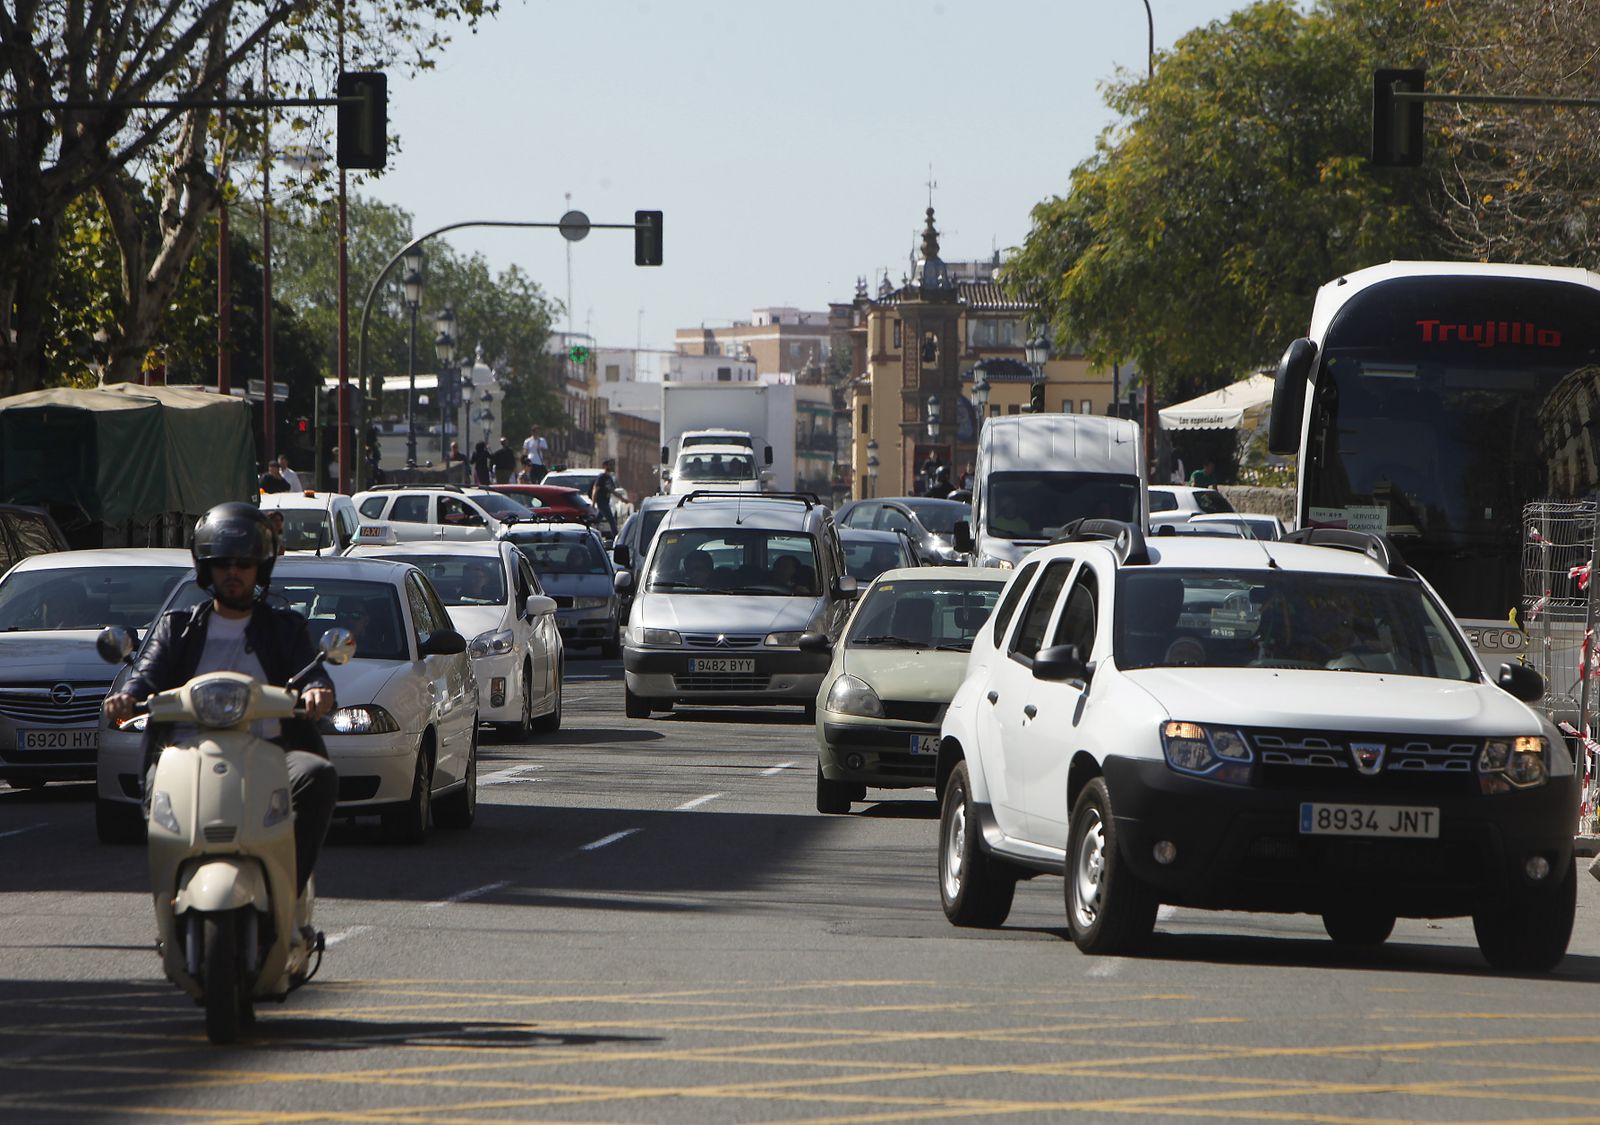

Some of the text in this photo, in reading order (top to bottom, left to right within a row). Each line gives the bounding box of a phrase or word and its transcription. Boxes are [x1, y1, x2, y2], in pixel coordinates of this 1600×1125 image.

[1416, 320, 1562, 348] Trujillo
[361, 527, 380, 537] TAXI
[698, 660, 752, 672] 9482 BYY
[27, 733, 67, 748] 6920
[1317, 807, 1379, 831] 8934
[1389, 810, 1434, 833] JNT
